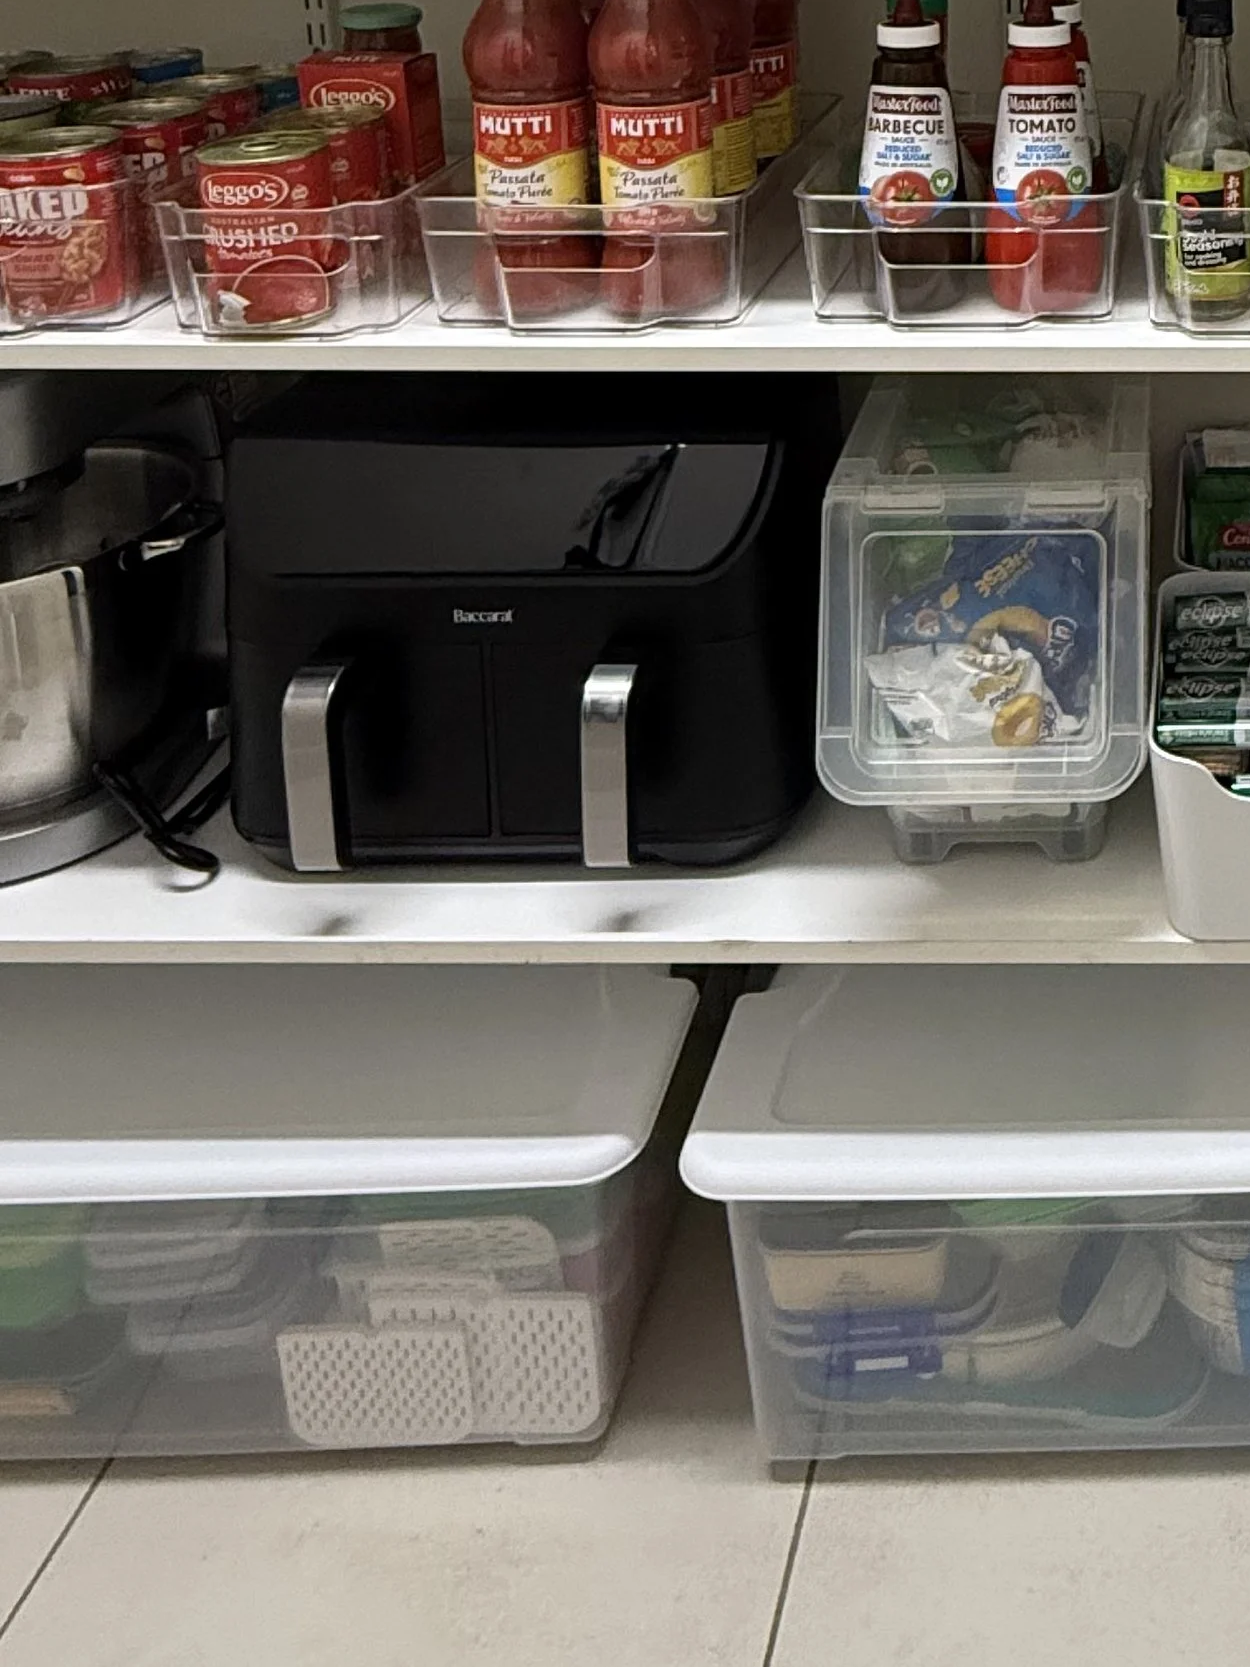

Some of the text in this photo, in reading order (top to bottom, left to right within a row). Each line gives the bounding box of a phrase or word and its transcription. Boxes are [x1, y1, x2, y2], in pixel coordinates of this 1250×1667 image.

[751, 55, 785, 74] TTI
[480, 115, 553, 136] MUTTI
[610, 115, 684, 137] MUTTI
[868, 117, 945, 135] BARBECUE
[1008, 118, 1076, 134] TOMATO
[891, 136, 915, 145] SAUCE
[1031, 136, 1056, 144] SAUCE
[884, 145, 922, 153] REDUCED
[1025, 144, 1062, 153] REDUCED
[488, 169, 545, 184] Passata
[620, 171, 678, 186] Passata
[206, 179, 279, 206] Leggo's
[482, 183, 516, 199] Tomato
[613, 185, 649, 199] Tomato
[0, 186, 88, 221] AKED
[202, 221, 299, 250] CRUSHED
[453, 608, 513, 624] Baccarat
[1180, 603, 1245, 624] eclipse
[1168, 634, 1233, 651] eclipse
[1181, 650, 1247, 664] eclipse
[1165, 681, 1236, 696] eclipse
